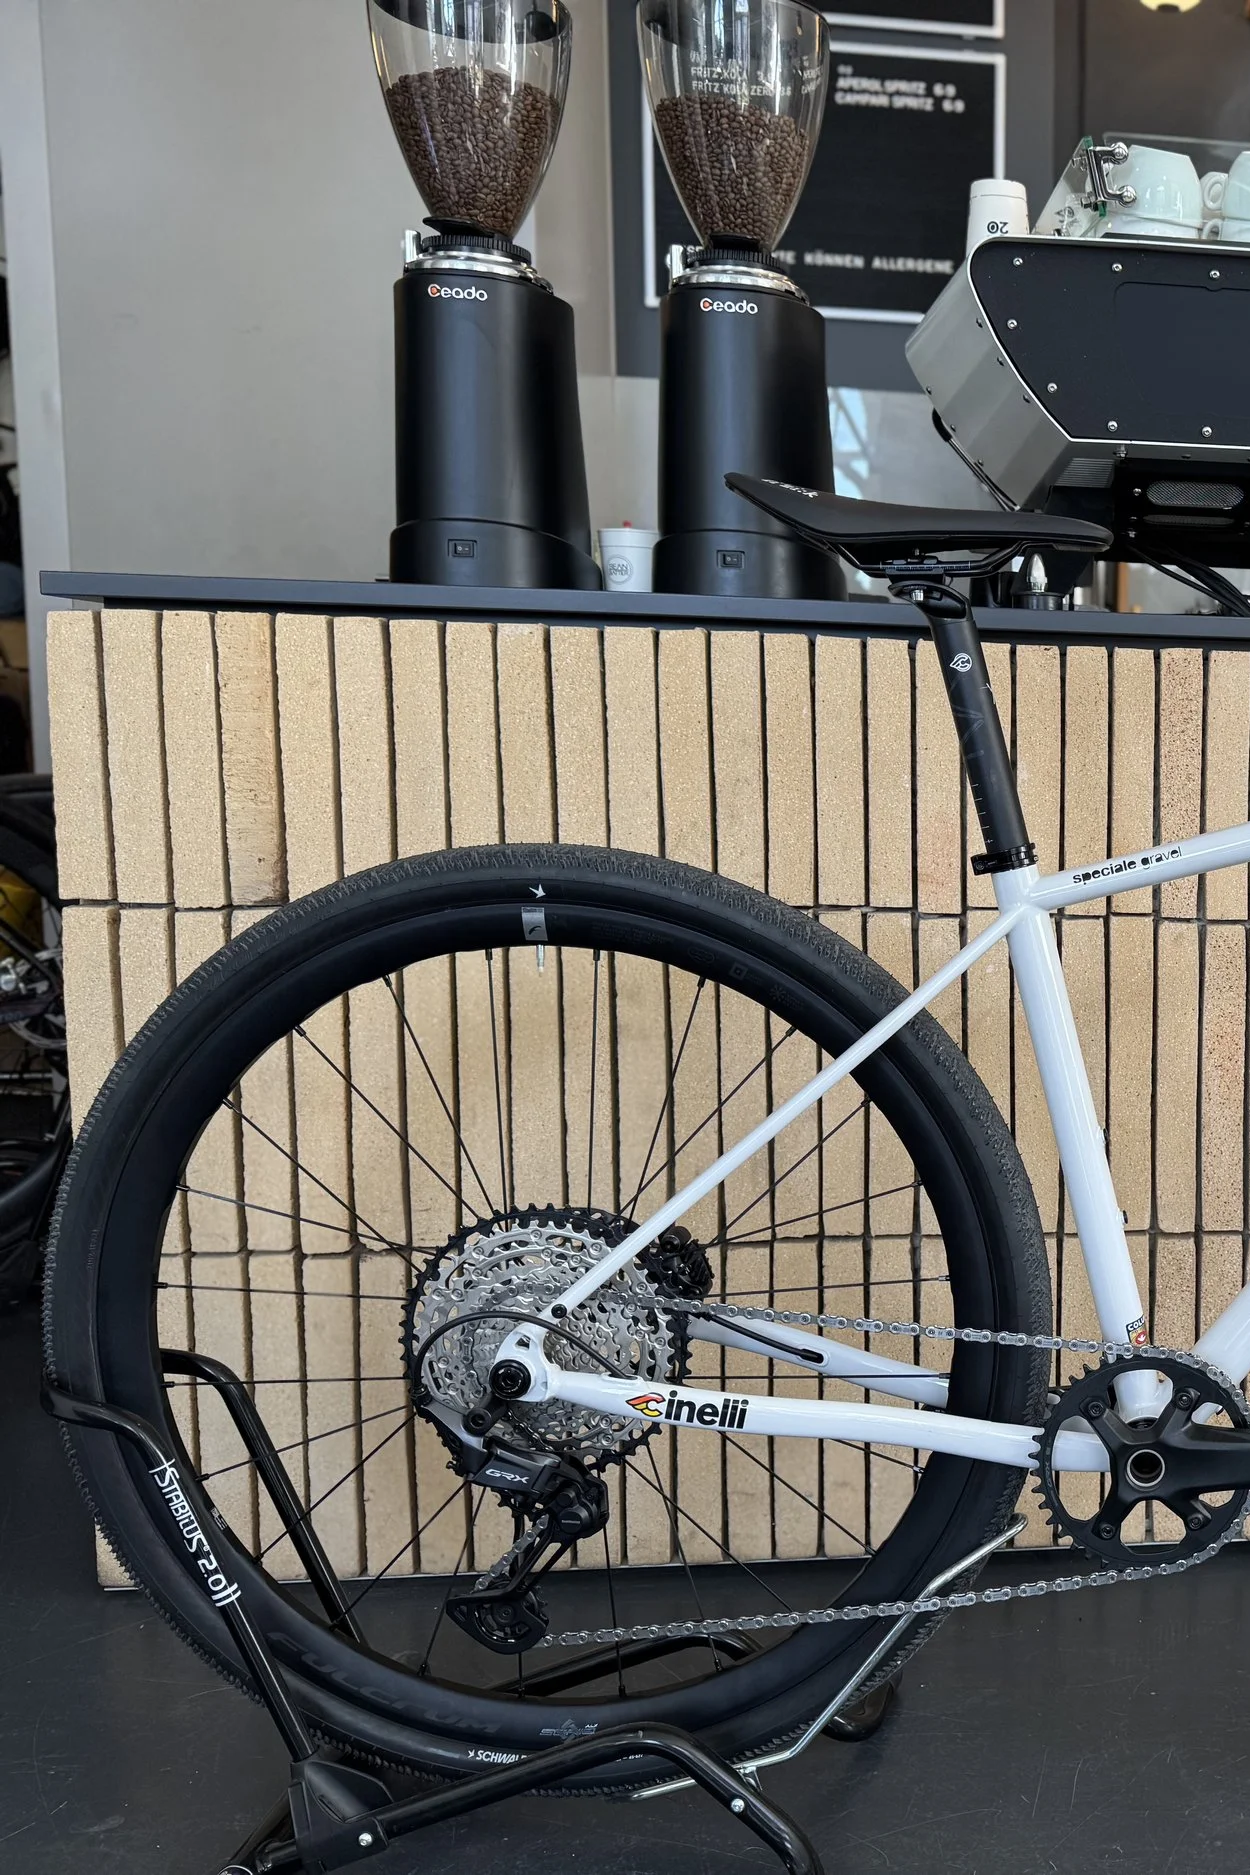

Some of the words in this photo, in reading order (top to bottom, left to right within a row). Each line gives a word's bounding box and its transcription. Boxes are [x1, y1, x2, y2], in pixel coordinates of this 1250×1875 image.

[803, 249, 865, 270] KÖNNEN
[870, 255, 955, 276] ALLERGENE
[427, 283, 488, 302] Ceado
[700, 297, 759, 315] Ceado
[1072, 859, 1137, 885] speciale
[1140, 845, 1183, 870] gravel
[1127, 1316, 1145, 1331] COLU
[485, 1468, 530, 1484] GRX
[197, 1554, 227, 1592] 2.0
[476, 1749, 530, 1764] SCHWA
